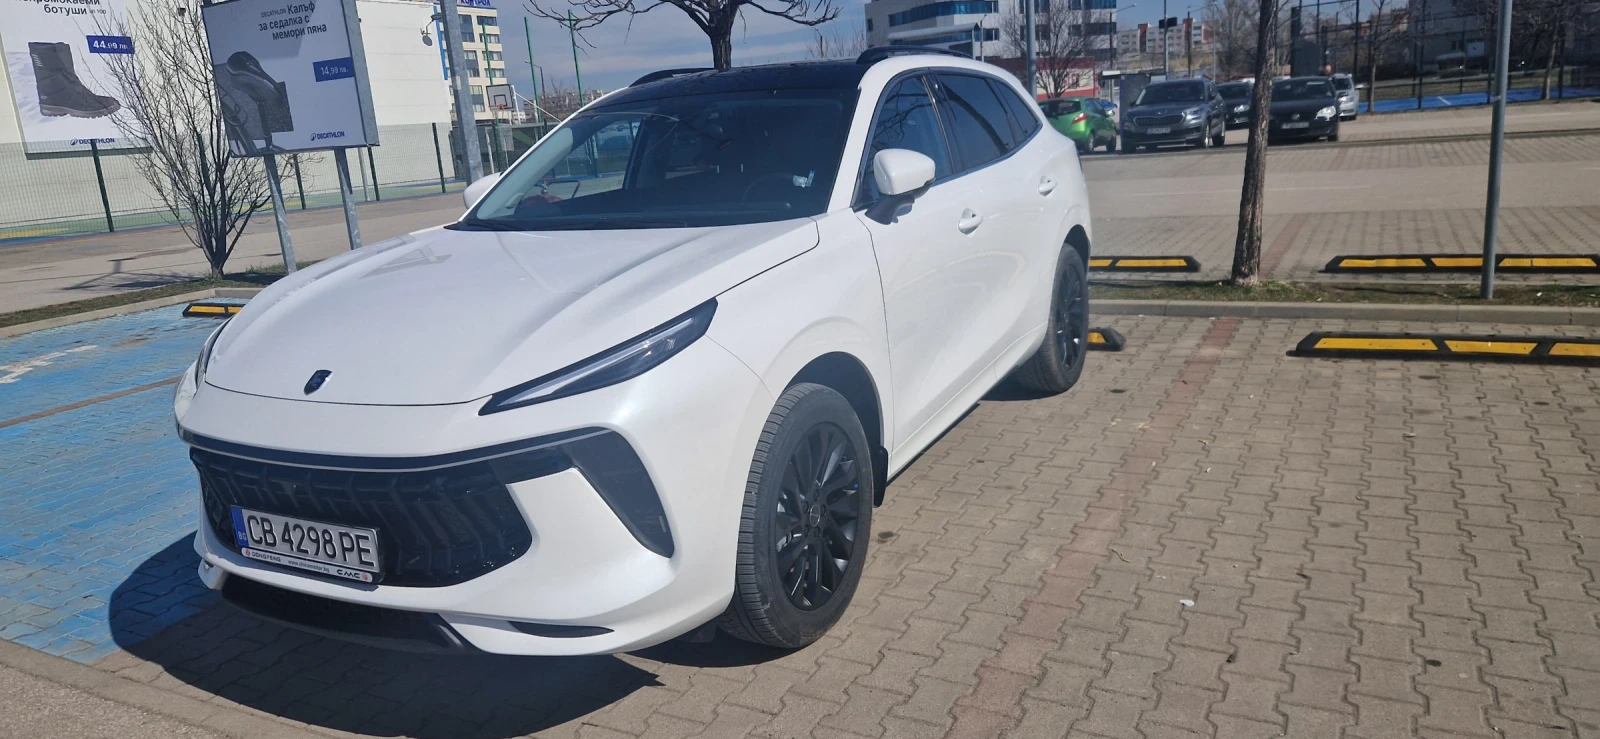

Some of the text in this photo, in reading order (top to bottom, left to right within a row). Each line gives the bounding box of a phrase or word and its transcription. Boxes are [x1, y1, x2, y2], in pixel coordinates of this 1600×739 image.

[44, 5, 87, 16] ботуши
[261, 1, 315, 18] DECATHLON Калъф
[258, 15, 310, 31] за седалка с
[272, 23, 327, 40] мемори пяна
[320, 65, 339, 76] 14,99
[316, 130, 345, 140] DECATHLON
[237, 531, 247, 541] BG
[247, 515, 376, 568] CB 4298 PE
[252, 551, 281, 562] DONGFENG
[336, 568, 361, 579] CMC
